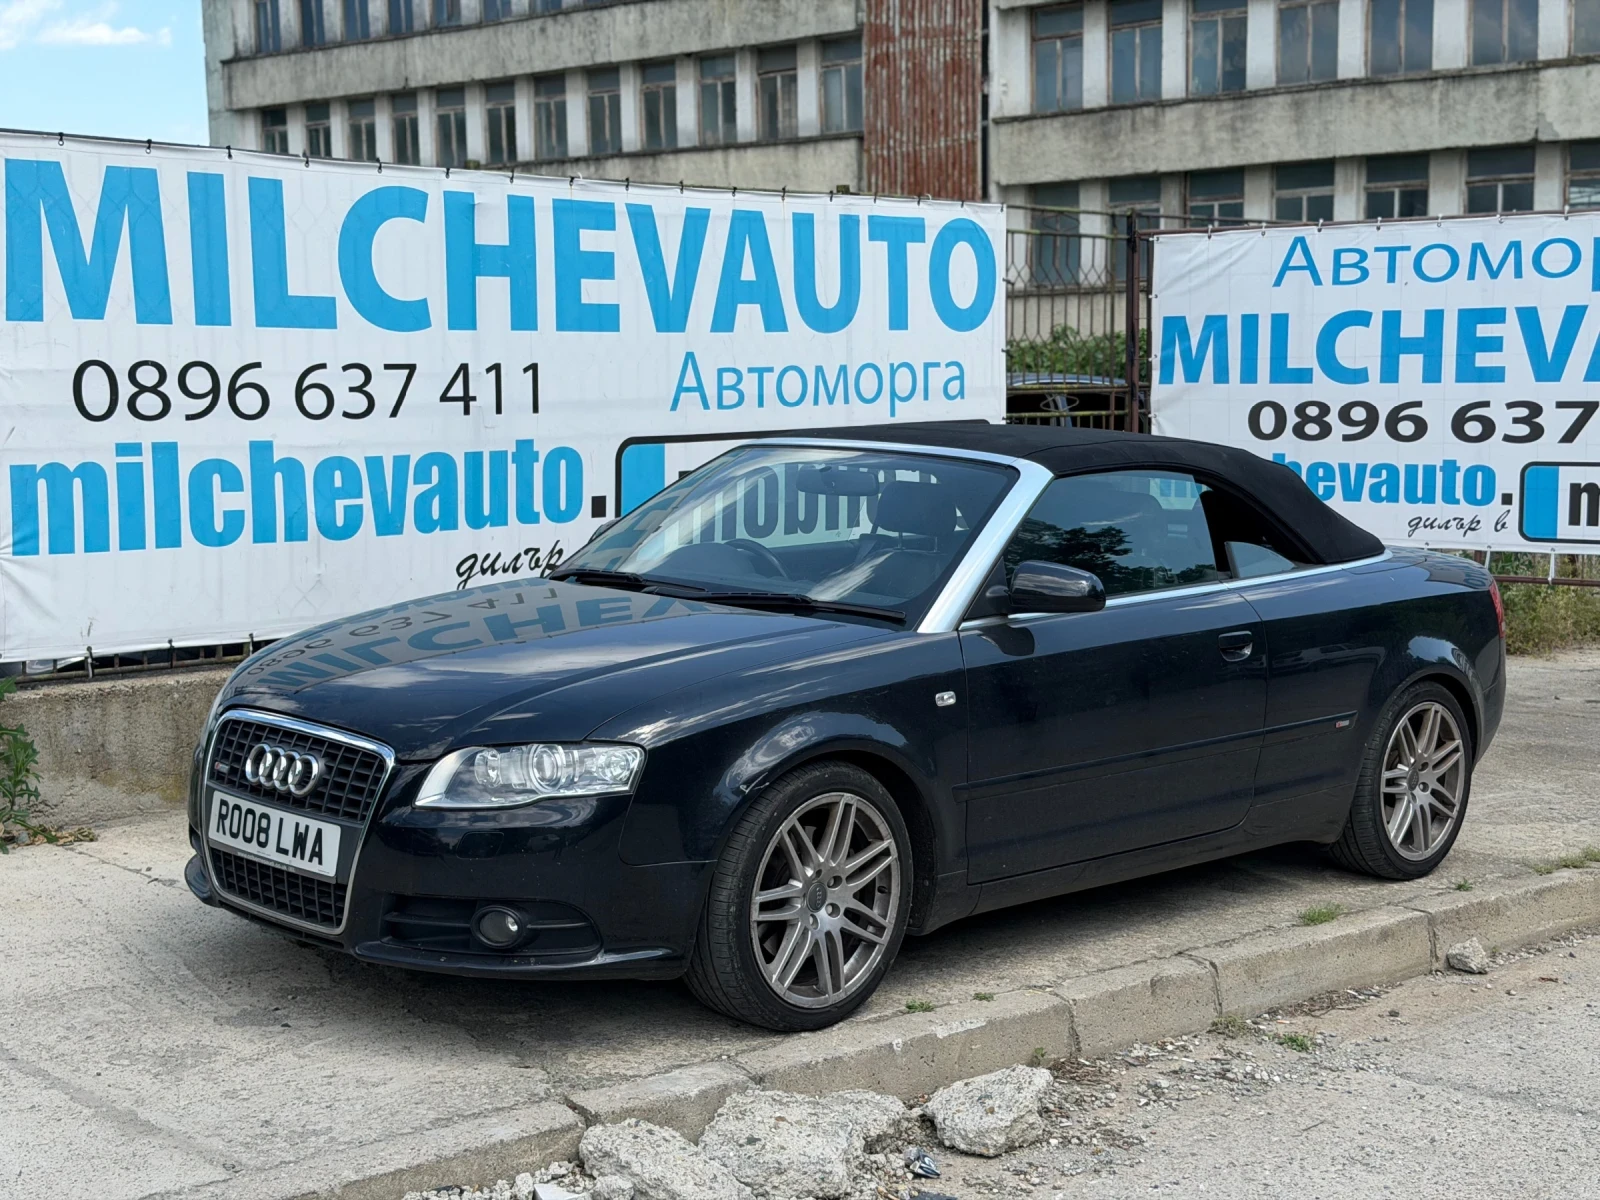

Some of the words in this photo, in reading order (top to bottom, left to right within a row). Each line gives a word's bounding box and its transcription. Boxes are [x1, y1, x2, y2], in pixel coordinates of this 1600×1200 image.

[5, 158, 997, 334] MILCHEVAUTO
[1272, 235, 1600, 293] Автомо
[72, 359, 270, 422] 0896
[294, 362, 417, 420] 637
[439, 362, 539, 416] 411
[670, 351, 966, 418] Автоморга
[1247, 400, 1428, 443] 0896
[1450, 400, 1600, 444] 637
[1407, 514, 1482, 538] дилър
[275, 816, 323, 866] LWA
